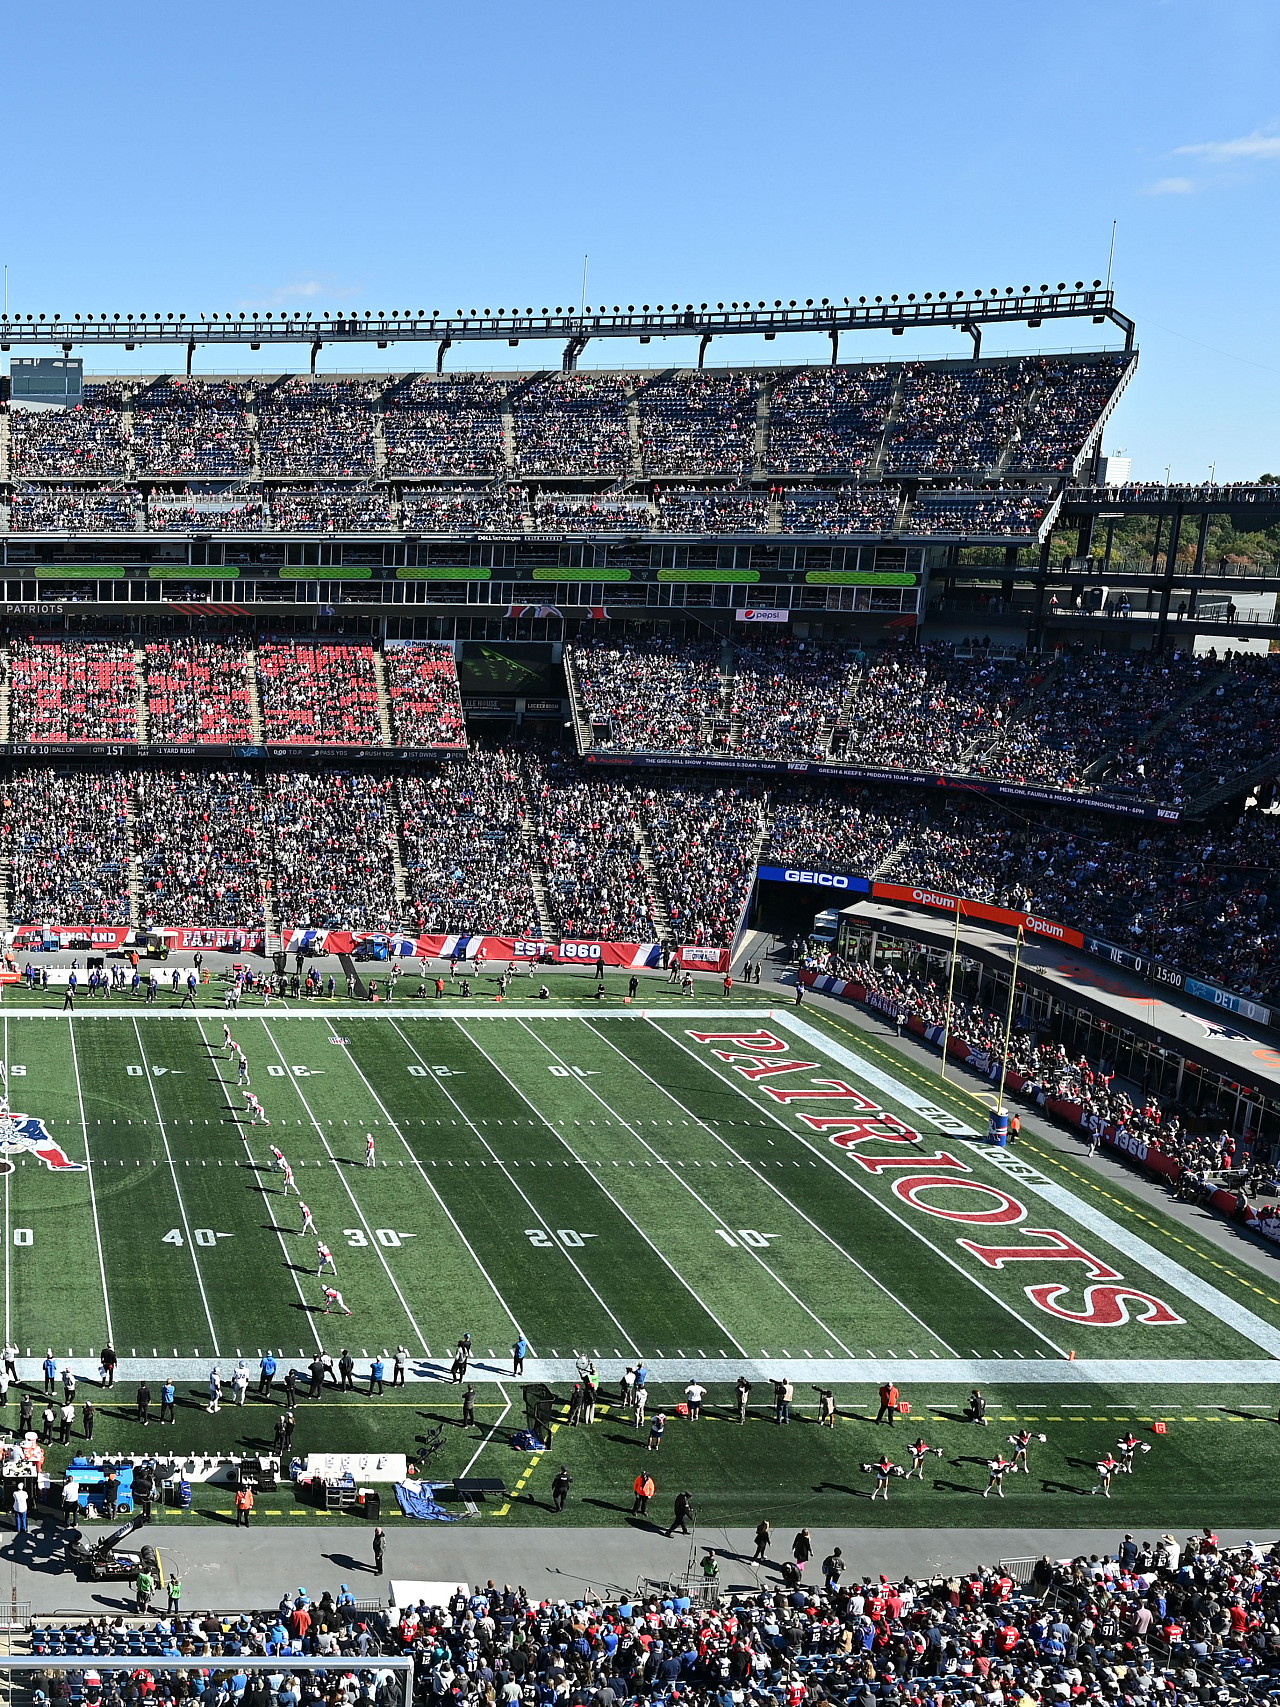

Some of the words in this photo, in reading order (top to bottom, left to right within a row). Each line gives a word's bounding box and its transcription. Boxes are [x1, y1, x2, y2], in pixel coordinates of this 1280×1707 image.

[7, 605, 63, 614] PATRIOTS
[756, 611, 780, 621] pepsi
[12, 746, 29, 754] 1ST
[38, 746, 49, 754] 10
[106, 746, 124, 755] 1ST
[866, 772, 892, 780] MIDDAYS
[1027, 791, 1048, 799] FAURIA
[1076, 798, 1115, 810] AFTERNOONS
[1116, 804, 1128, 812] 2PM
[1157, 809, 1179, 820] WEEI
[784, 870, 849, 889] GEICO
[913, 890, 955, 908] Optum
[1025, 916, 1064, 938] Optum
[514, 942, 553, 957] EST.
[560, 944, 602, 959] 1960
[1110, 949, 1123, 964] NE
[1135, 957, 1142, 971] 0
[1156, 967, 1182, 987] 15:00
[1214, 989, 1234, 1009] DET
[1248, 1004, 1255, 1018] 0
[126, 1065, 173, 1077] 40
[267, 1065, 314, 1077] 30
[407, 1065, 455, 1077] 20
[1080, 1113, 1110, 1140] EST.
[1114, 1128, 1148, 1161] 1960
[916, 1106, 964, 1129] END
[962, 1132, 1052, 1186] ACISM
[683, 1028, 1187, 1327] PATRIOTS
[161, 1228, 218, 1247] 40
[342, 1229, 403, 1248] 30
[524, 1230, 587, 1248] 20
[716, 1229, 773, 1248] 10
[1144, 1558, 1152, 1566] 12
[813, 1633, 820, 1641] 12
[1102, 1627, 1113, 1636] 91
[1006, 1635, 1015, 1644] 12
[468, 1661, 478, 1672] 11
